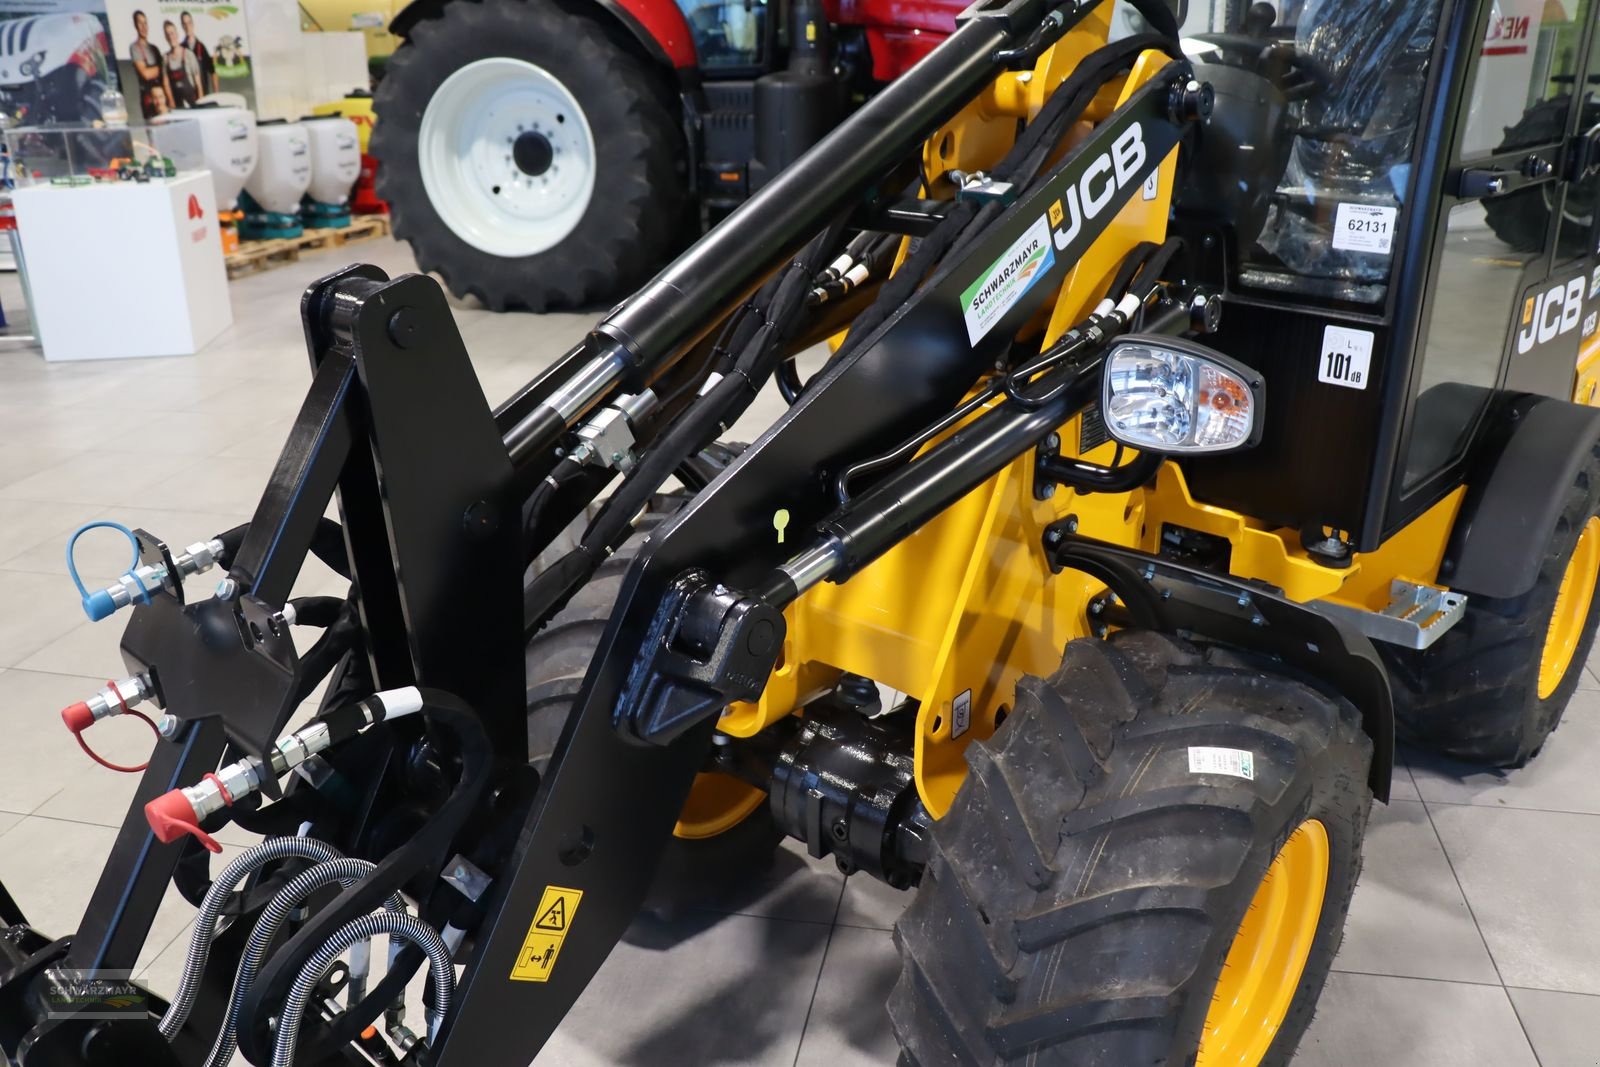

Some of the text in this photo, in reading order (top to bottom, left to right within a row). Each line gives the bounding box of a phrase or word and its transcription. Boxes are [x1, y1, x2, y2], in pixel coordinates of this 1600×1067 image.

[1054, 121, 1147, 251] JCB
[1348, 219, 1387, 233] 62131
[973, 239, 1039, 310] SCHWARZMAYR
[977, 277, 1017, 318] LANDTECHNIK
[1518, 275, 1586, 355] JCB
